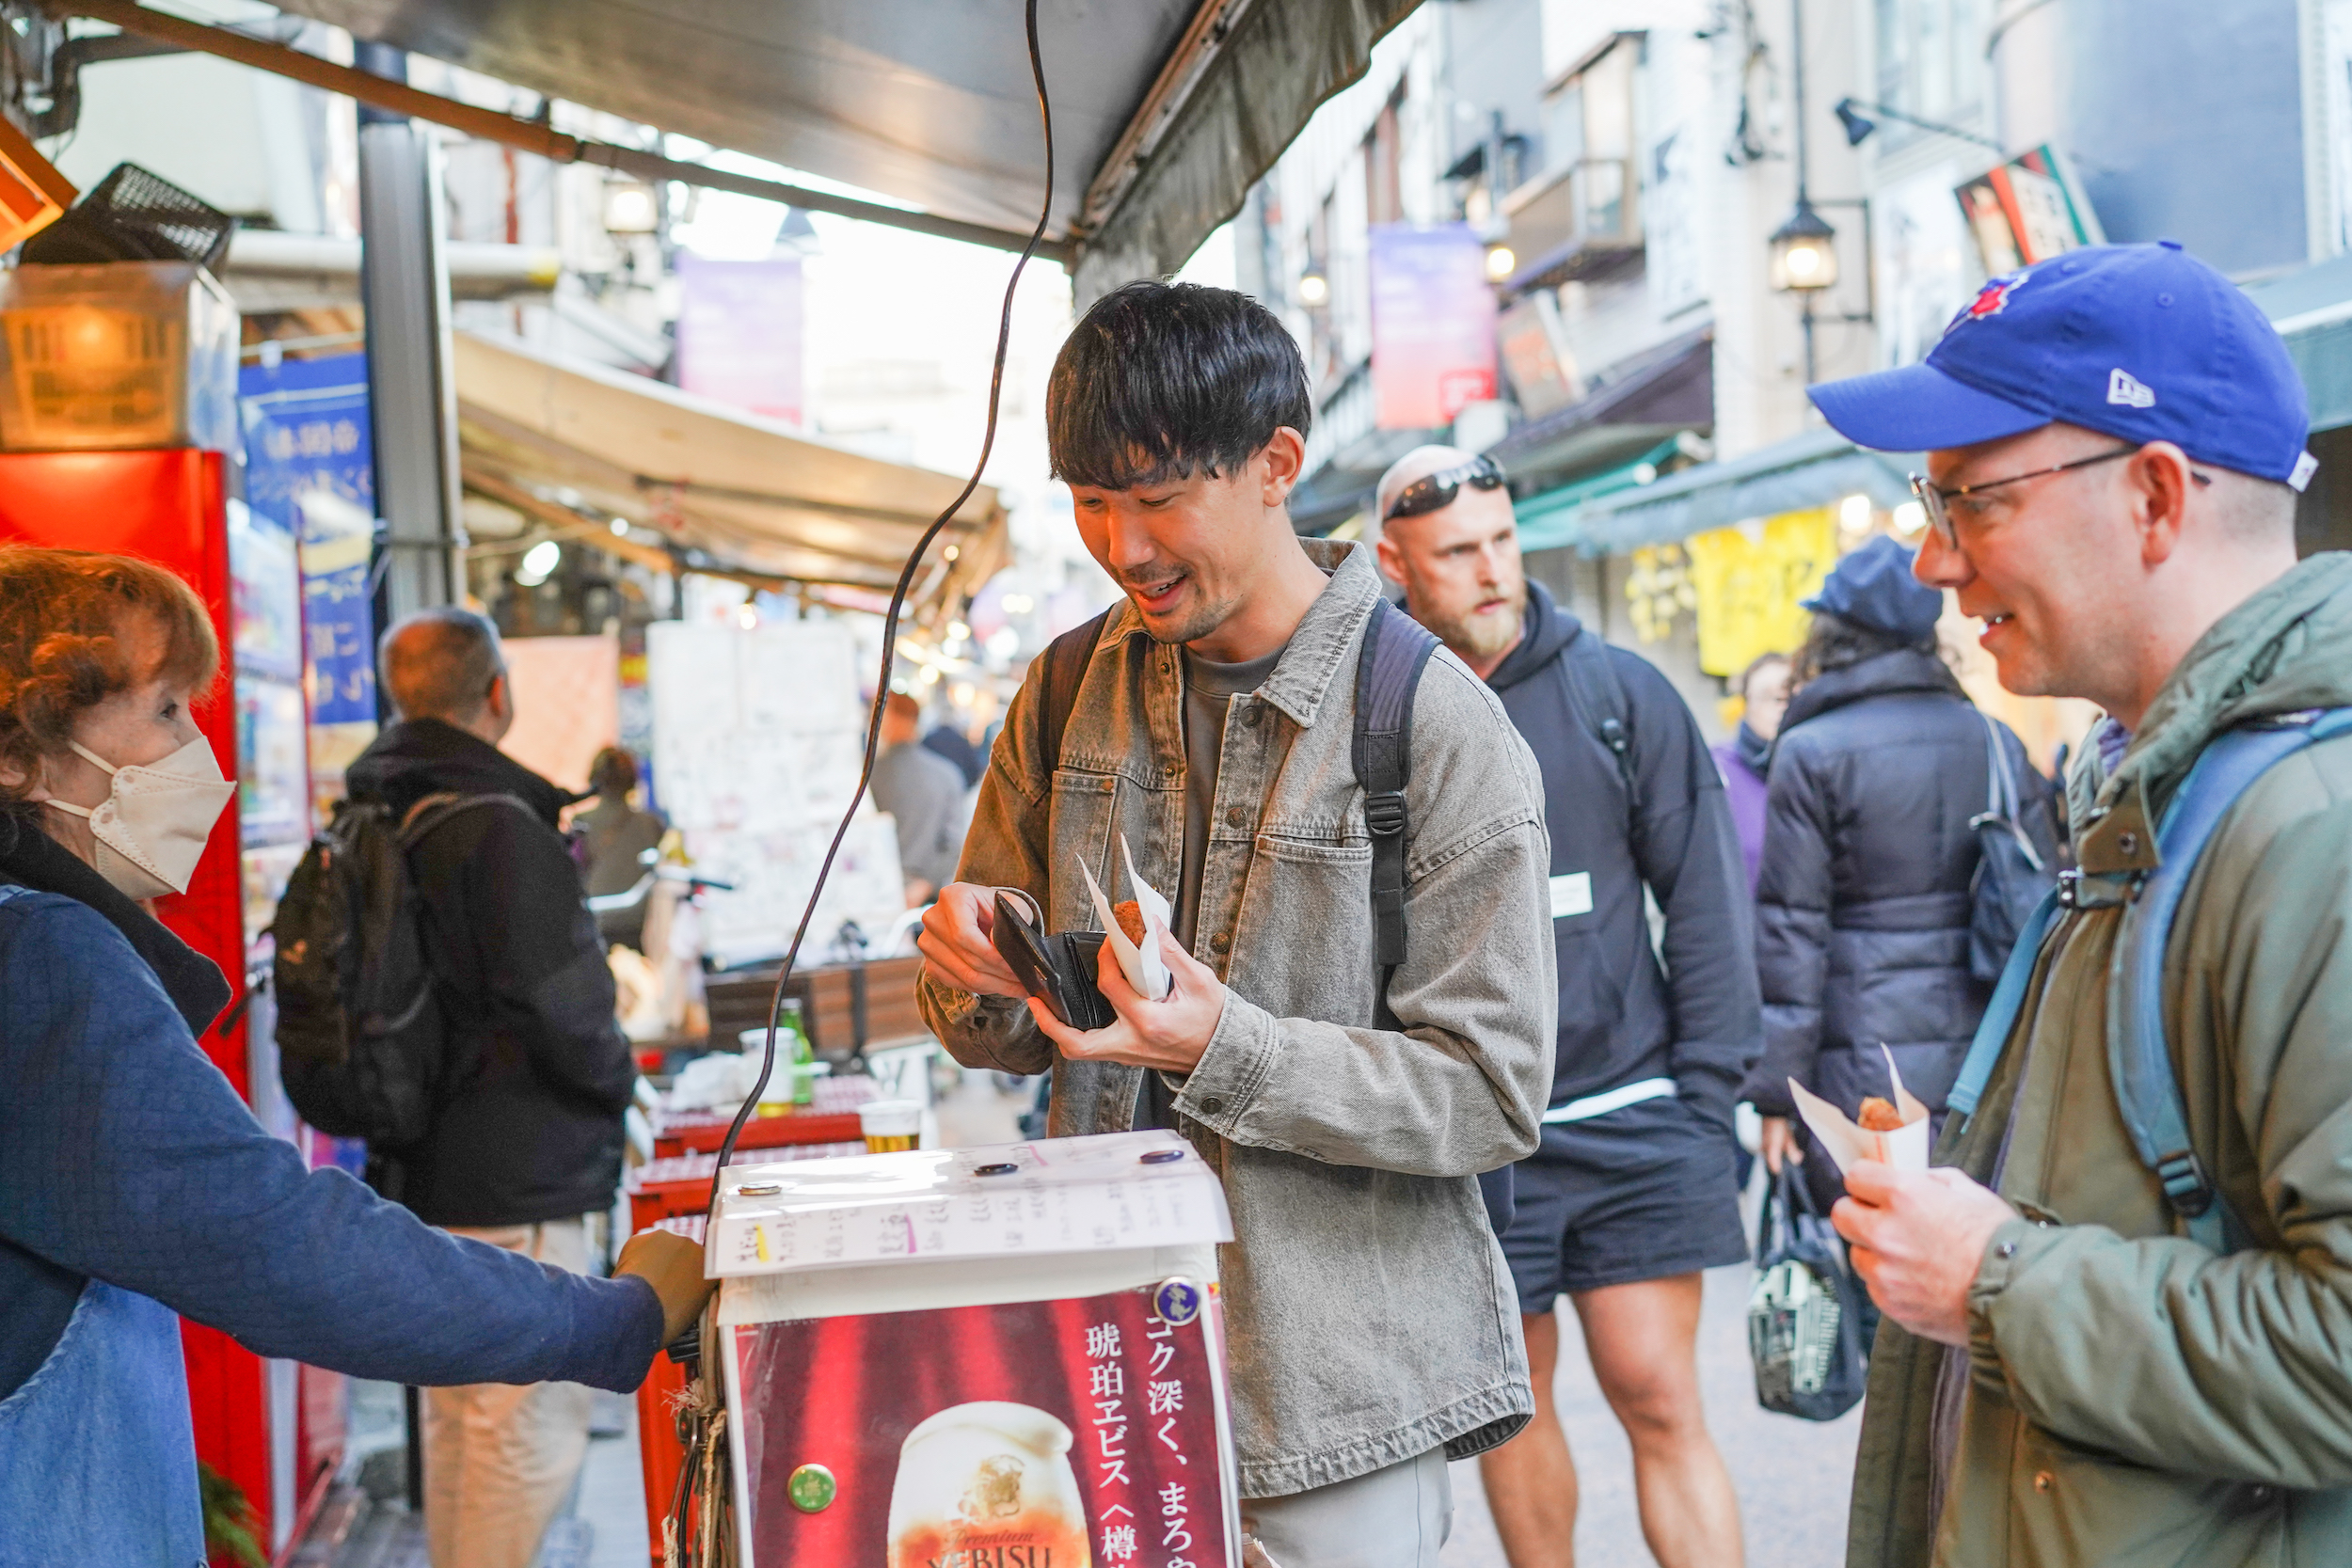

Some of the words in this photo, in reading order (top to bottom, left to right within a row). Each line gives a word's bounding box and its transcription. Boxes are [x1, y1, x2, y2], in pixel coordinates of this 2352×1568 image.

[1085, 1322, 1138, 1568] 琥珀ヱビス〈樽
[946, 1528, 1034, 1551] Premium
